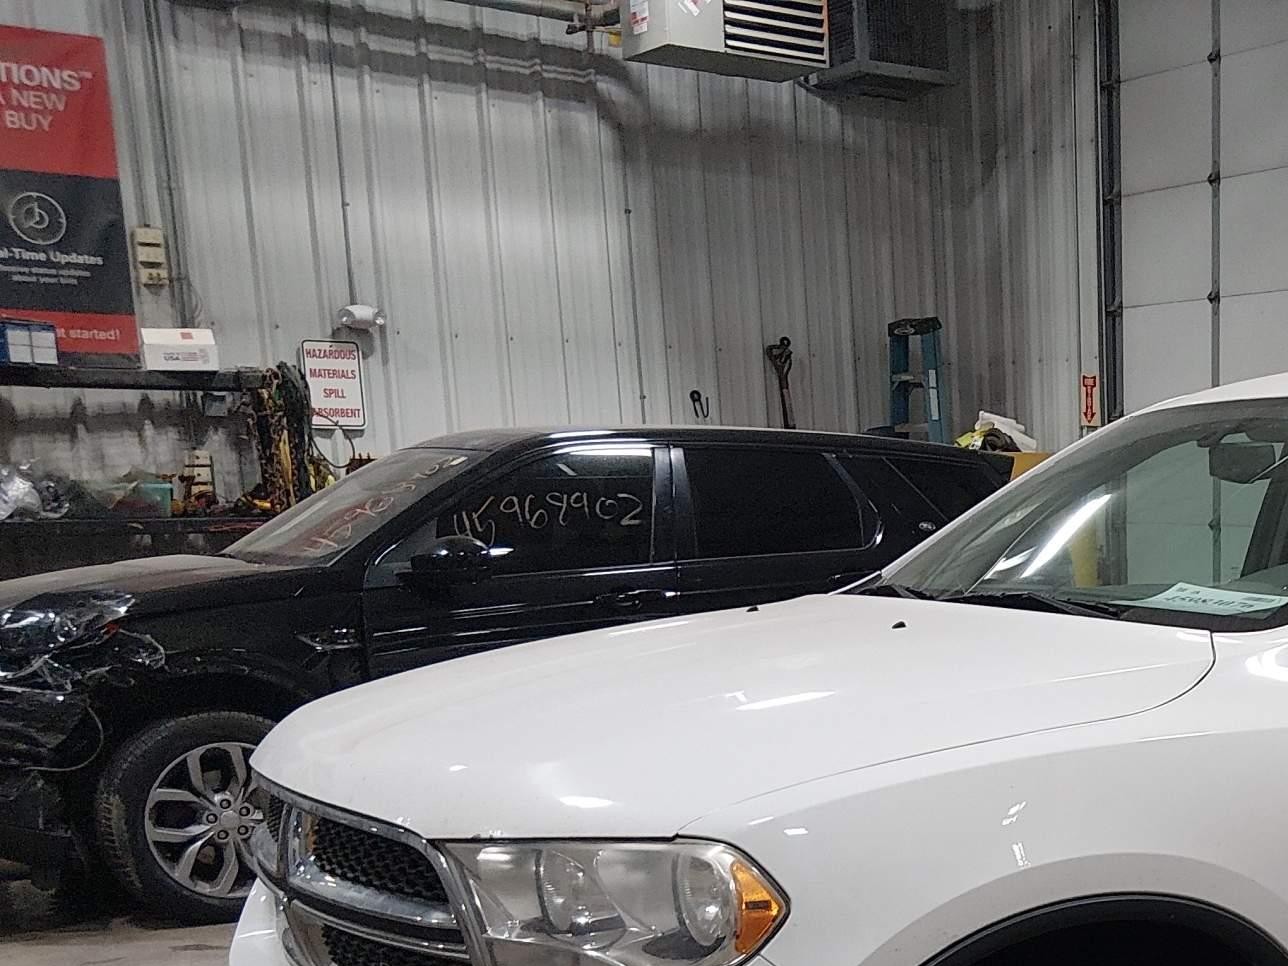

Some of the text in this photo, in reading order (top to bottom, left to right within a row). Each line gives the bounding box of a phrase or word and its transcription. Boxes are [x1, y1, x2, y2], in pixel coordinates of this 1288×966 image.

[11, 88, 66, 111] NEW
[6, 110, 53, 131] BUY
[49, 249, 104, 265] Updates
[69, 329, 120, 341] started!
[305, 348, 357, 361] HAZARDOUS
[309, 368, 357, 380] MATERIALS
[323, 388, 346, 399] SPILL
